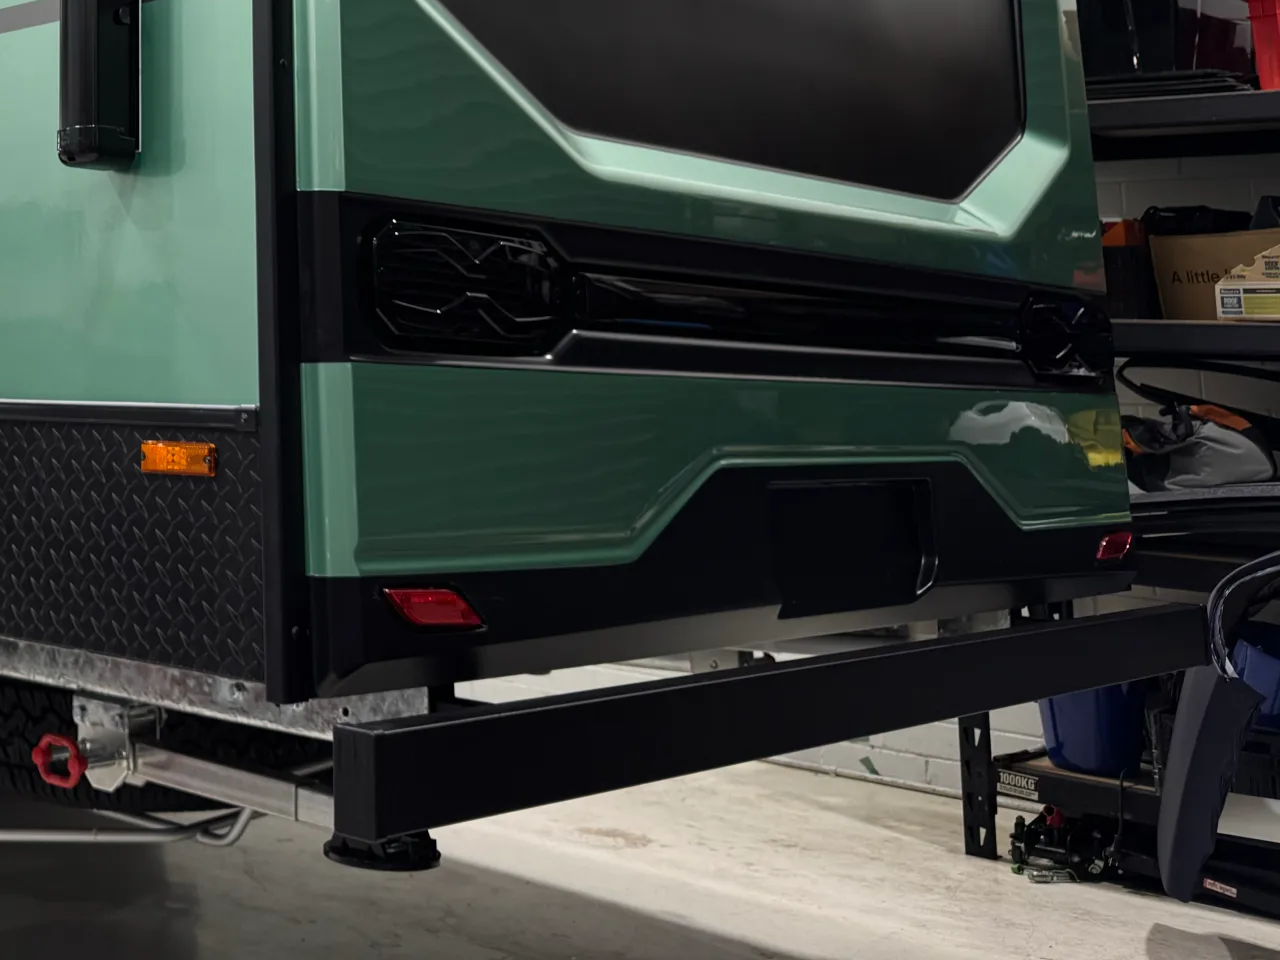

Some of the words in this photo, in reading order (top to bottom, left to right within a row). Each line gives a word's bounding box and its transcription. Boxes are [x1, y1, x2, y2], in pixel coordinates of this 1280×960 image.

[1172, 271, 1182, 284] A
[1187, 270, 1220, 284] little
[999, 771, 1035, 790] 1000KG
